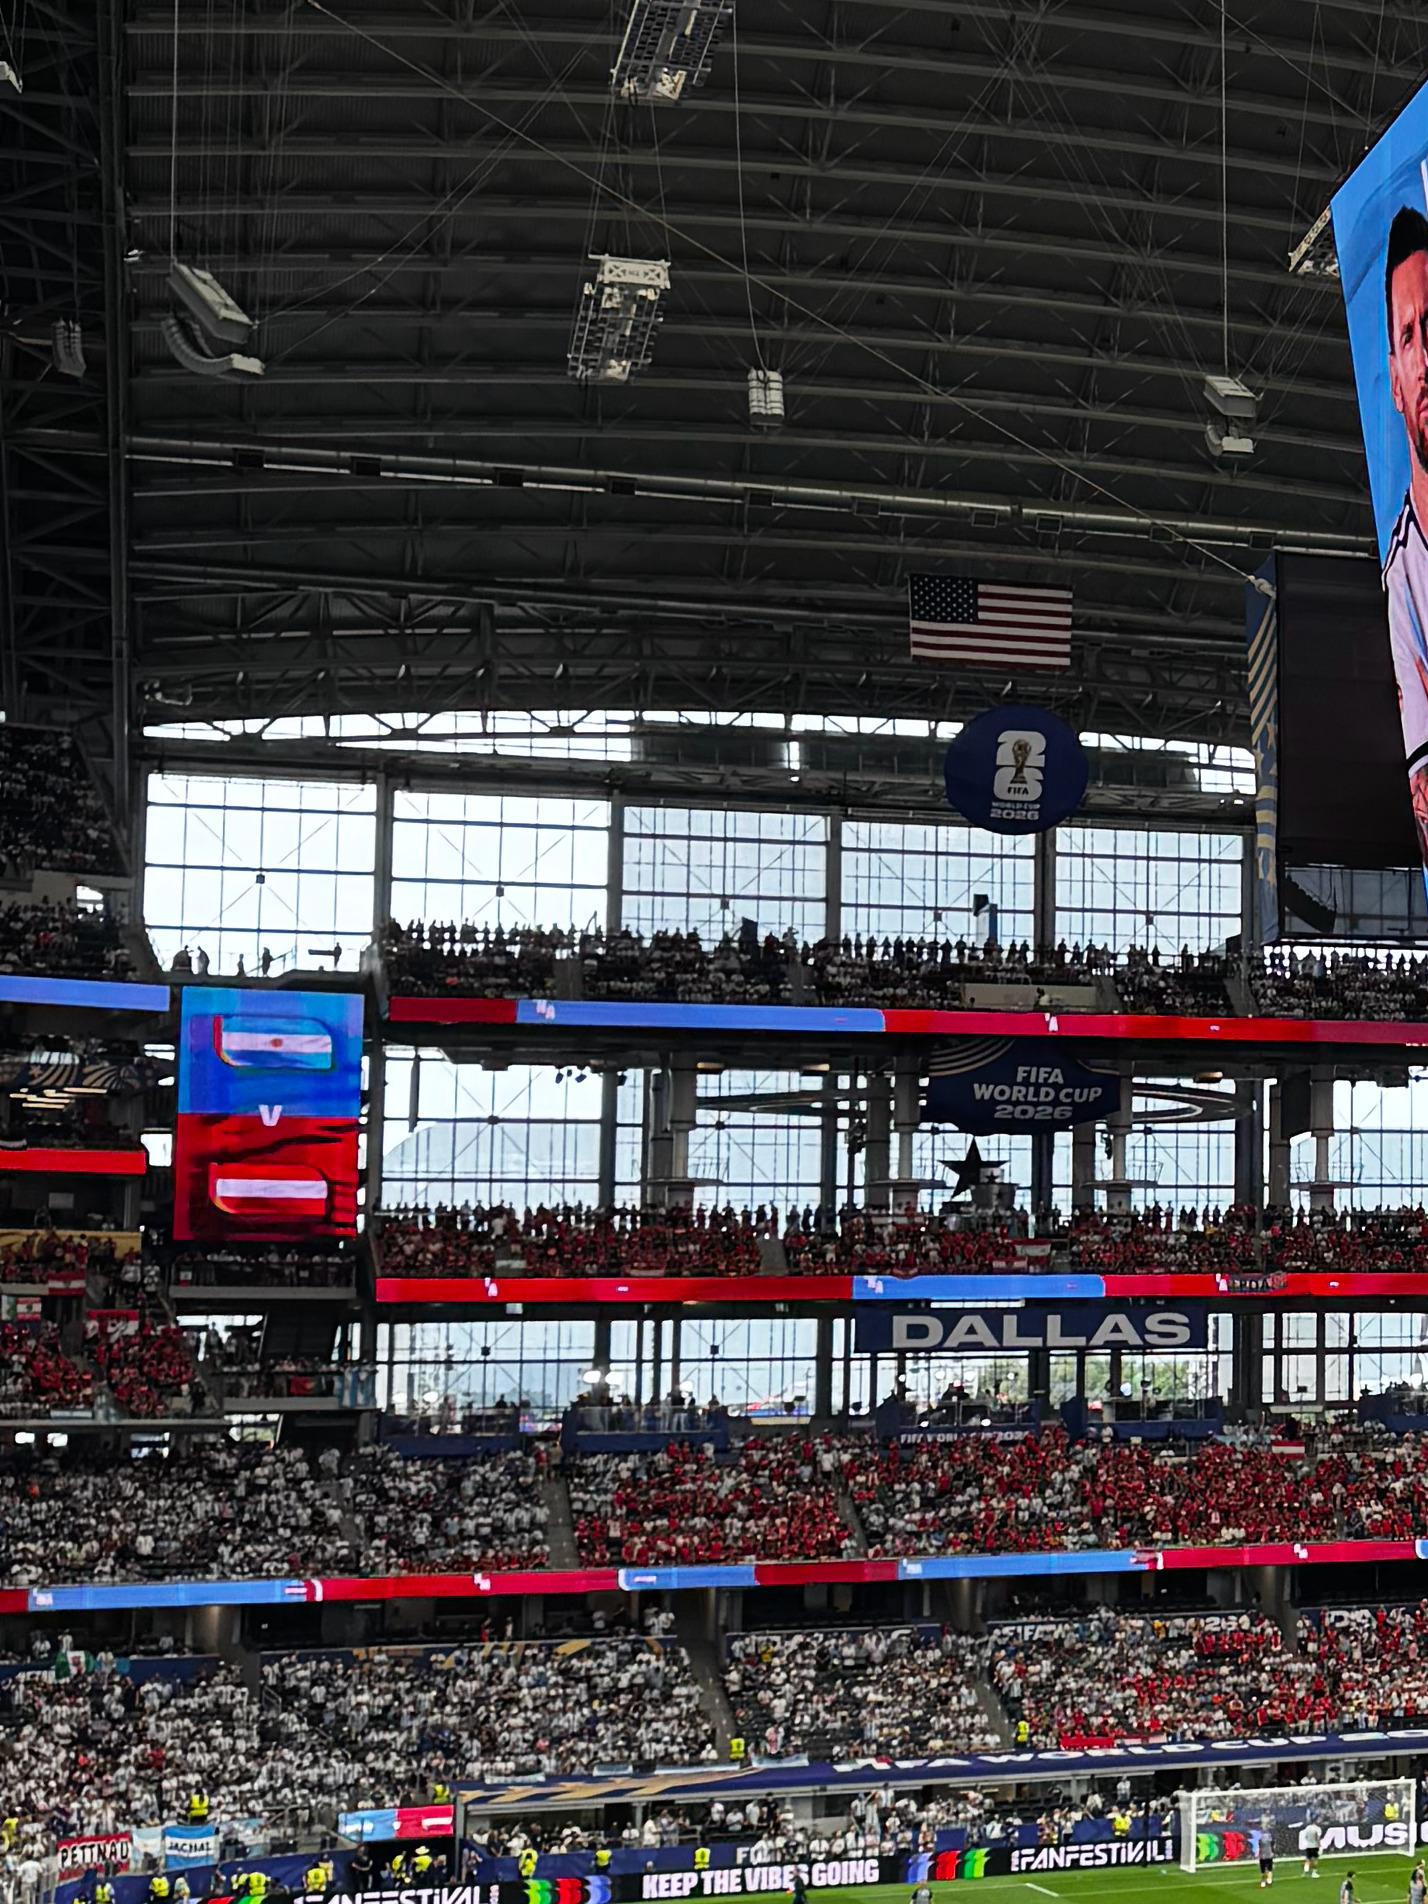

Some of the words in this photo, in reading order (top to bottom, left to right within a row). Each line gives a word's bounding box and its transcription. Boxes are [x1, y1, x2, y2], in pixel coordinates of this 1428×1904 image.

[1008, 786, 1029, 795] FIFA
[990, 808, 1039, 820] 2026
[1016, 1066, 1064, 1084] FIFA
[973, 1083, 1054, 1102] WORLD
[1059, 1086, 1102, 1103] CUP
[994, 1104, 1072, 1120] 2026
[892, 1312, 1191, 1348] DALLAS
[642, 1872, 698, 1899] KEEP
[700, 1868, 743, 1895] THE
[811, 1859, 880, 1887] GOING
